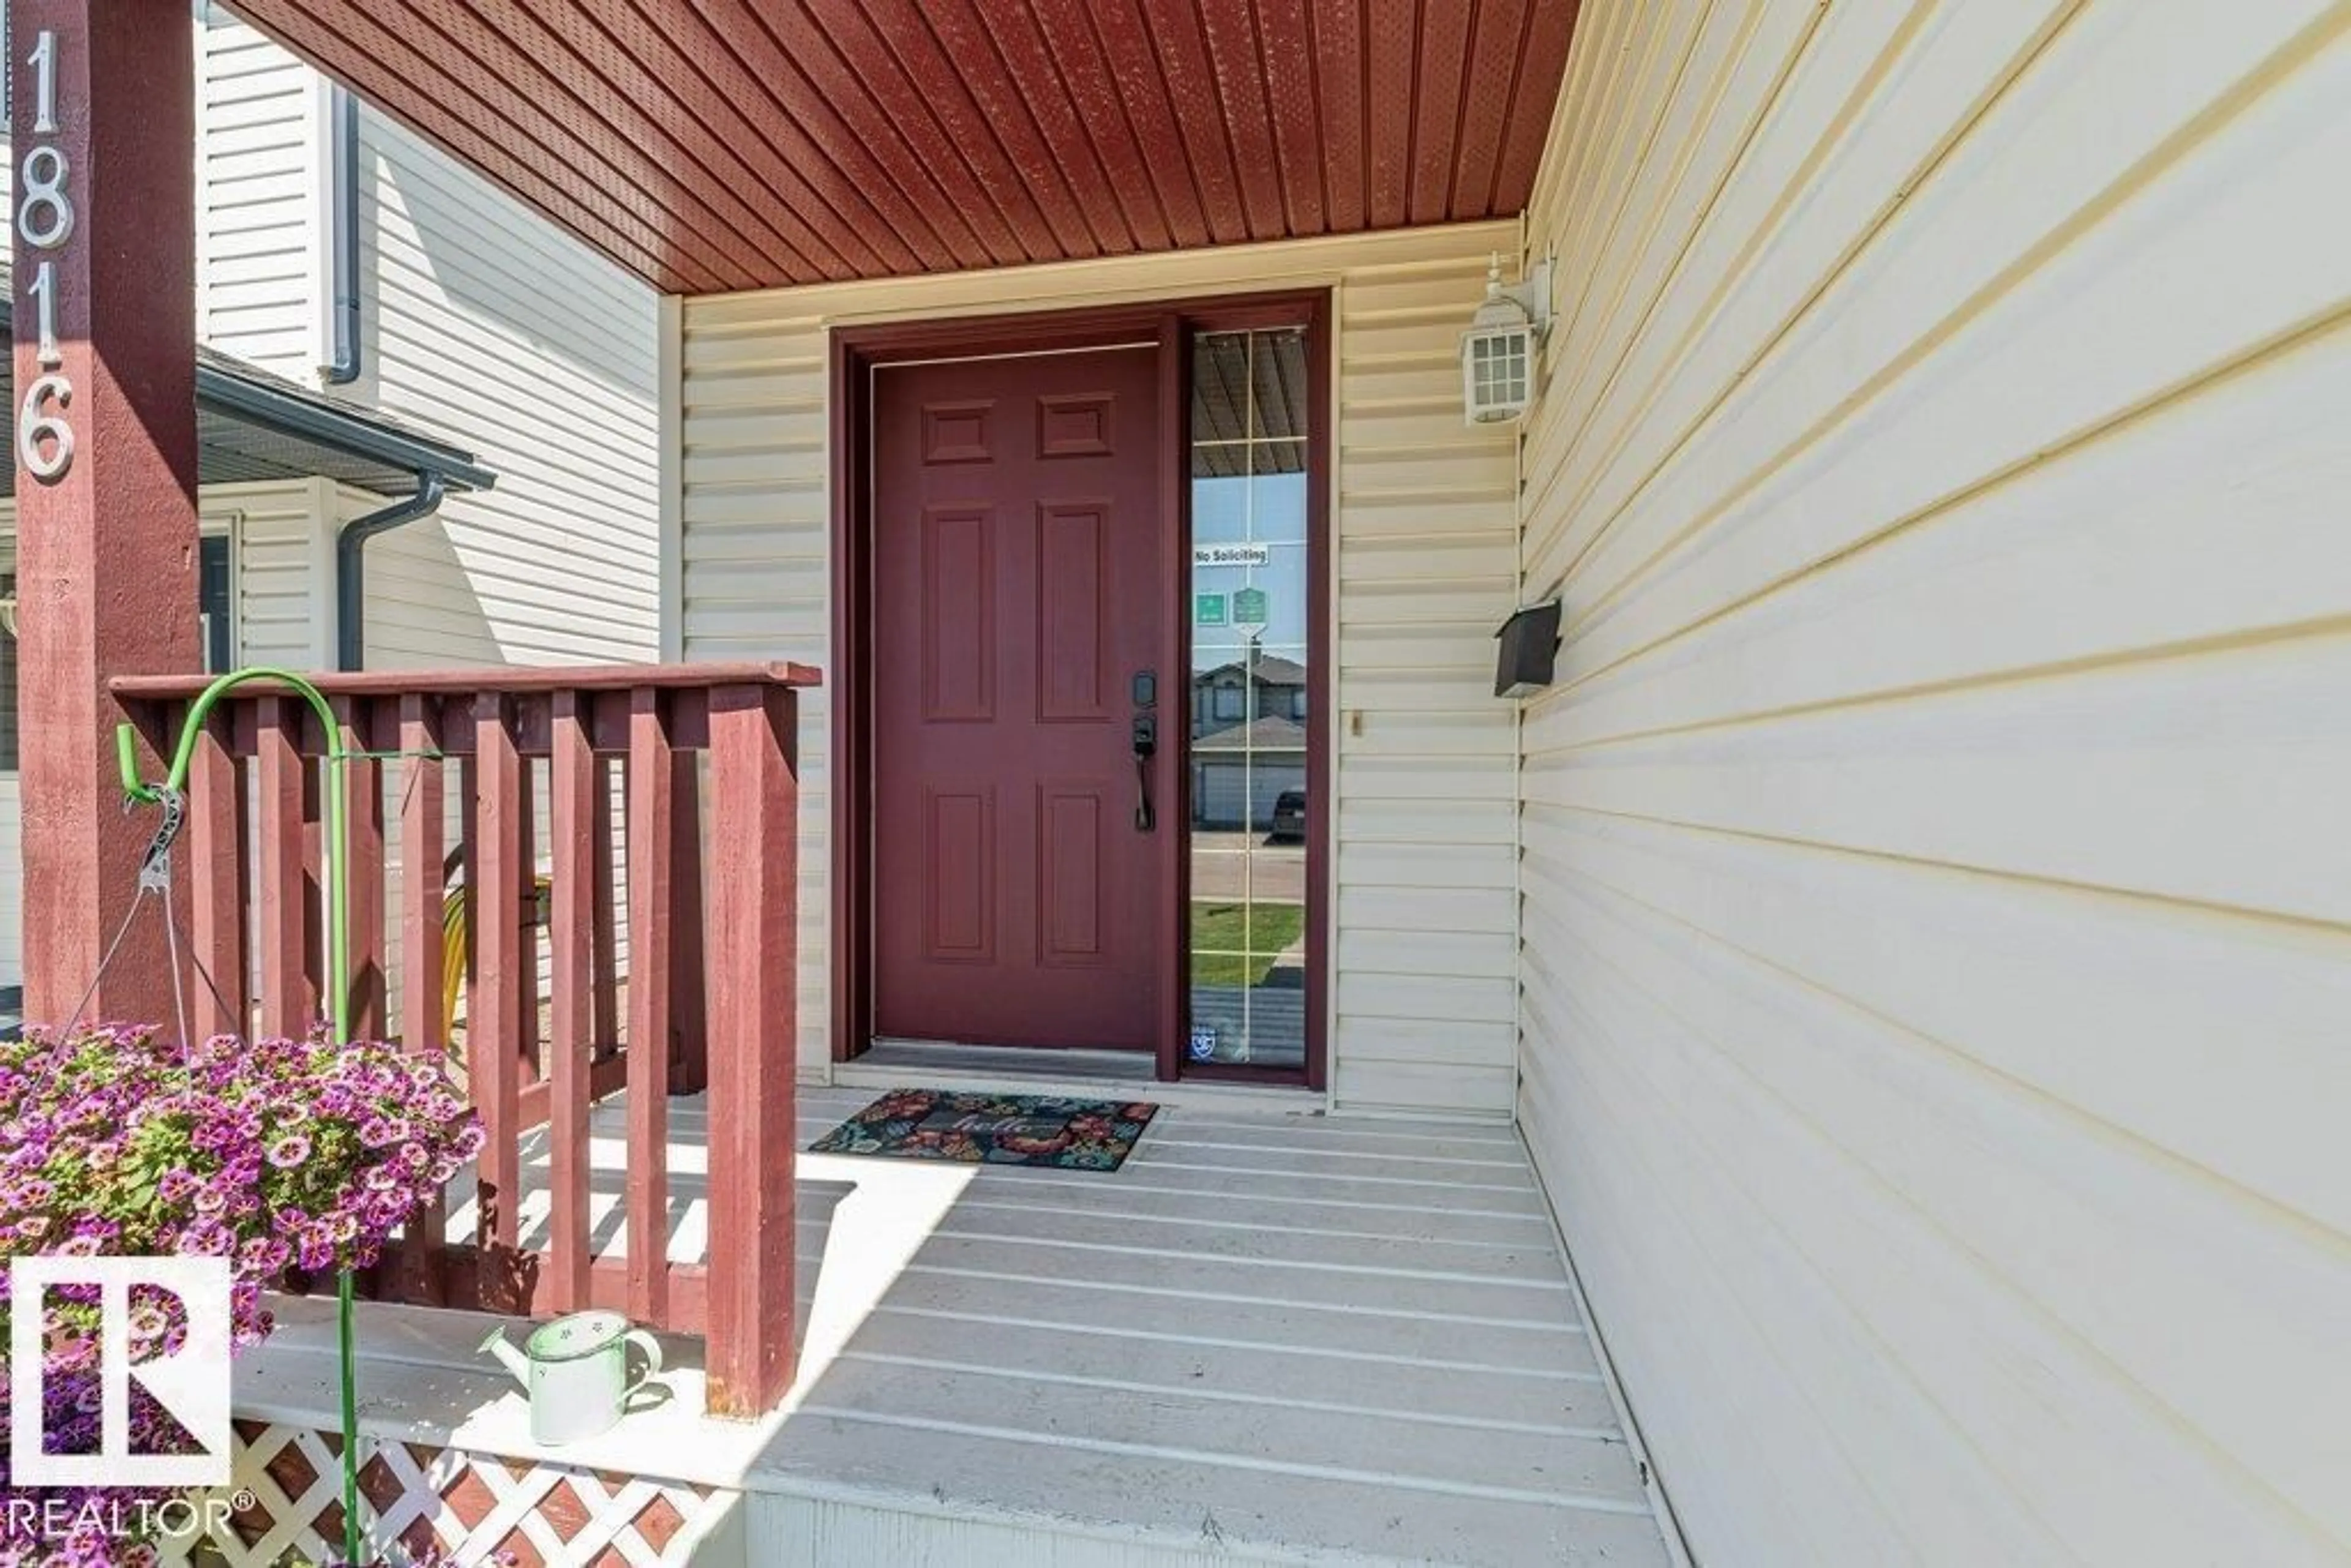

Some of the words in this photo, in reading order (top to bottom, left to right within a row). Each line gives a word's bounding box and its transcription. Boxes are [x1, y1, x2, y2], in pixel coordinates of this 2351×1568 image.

[18, 31, 75, 478] 1816
[1195, 550, 1210, 562] No
[1213, 549, 1266, 563] Soliciting
